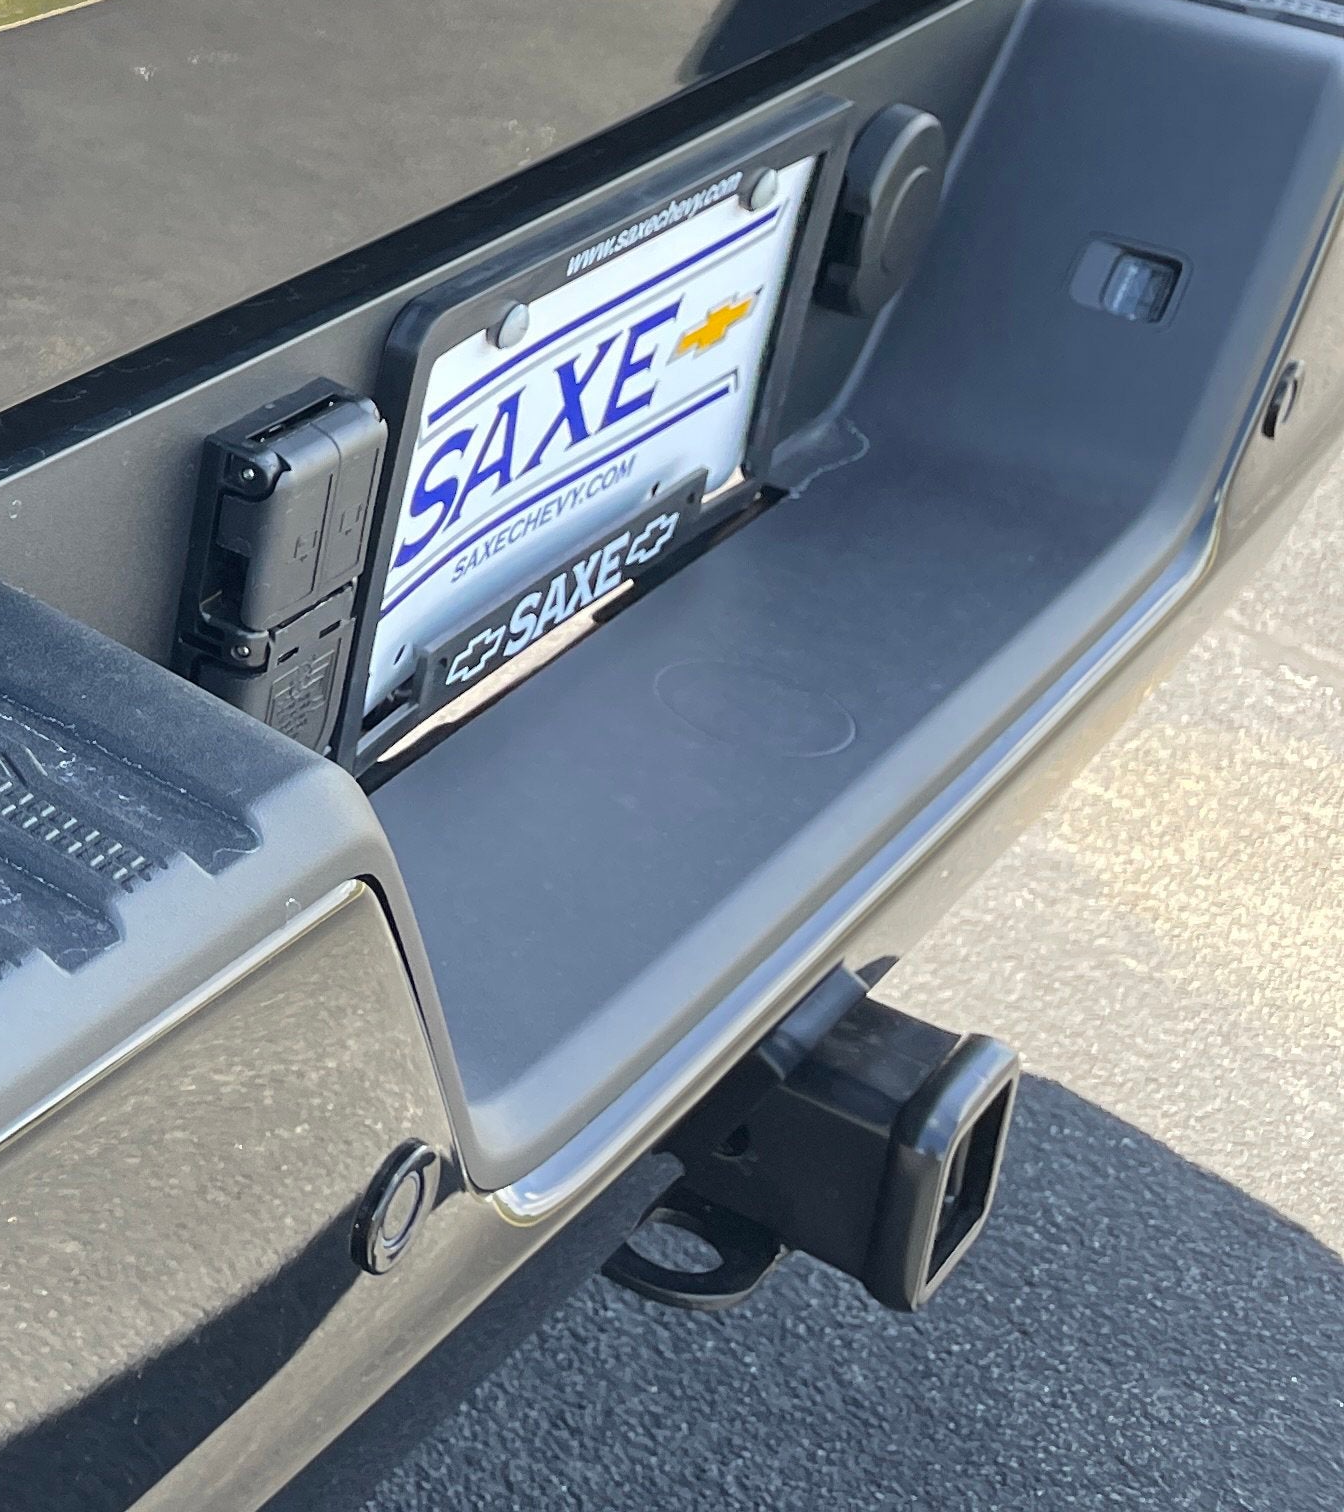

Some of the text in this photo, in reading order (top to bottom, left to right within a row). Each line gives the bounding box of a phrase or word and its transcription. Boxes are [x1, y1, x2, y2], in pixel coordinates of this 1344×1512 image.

[566, 171, 744, 277] www.saxechevy.com
[391, 293, 685, 570] SAXE
[450, 453, 637, 584] SAXECHEVY.COM
[503, 531, 631, 657] SAXE
